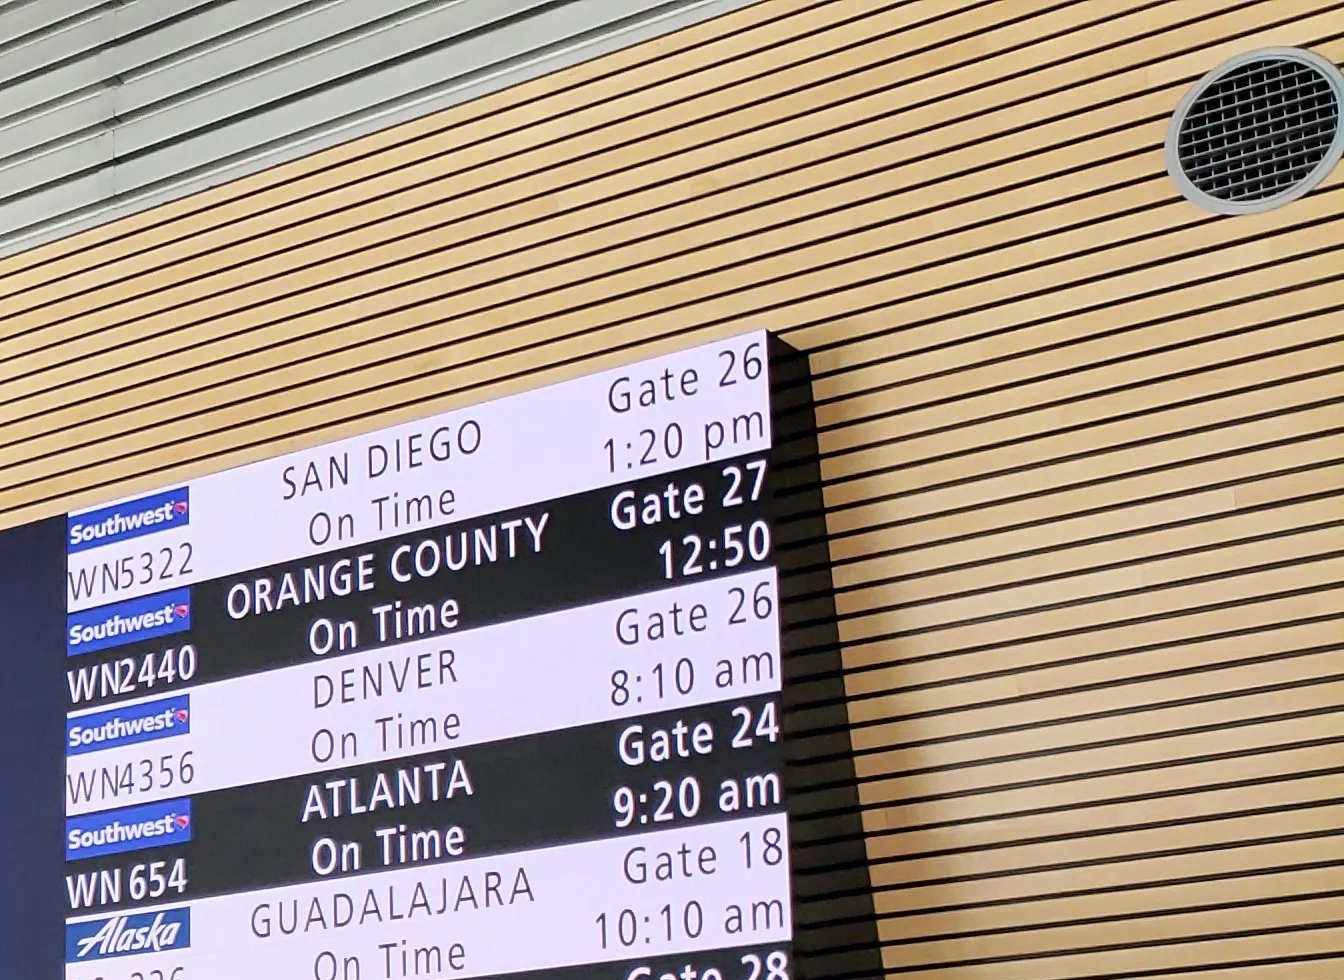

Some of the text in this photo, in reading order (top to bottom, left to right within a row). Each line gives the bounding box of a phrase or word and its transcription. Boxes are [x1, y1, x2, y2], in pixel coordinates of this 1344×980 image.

[607, 342, 763, 416] Gate 26
[281, 419, 483, 502] SAN DIEGO
[603, 409, 765, 473] 1:20 pm
[69, 502, 174, 544] Southwest
[308, 484, 456, 547] On Time
[610, 459, 769, 530] Gate 27
[68, 542, 194, 602] WN5322
[226, 514, 551, 619] ORANGE COUNTY
[658, 520, 772, 580] 12:50
[69, 606, 174, 646] Southwest
[308, 598, 460, 656] On Time
[615, 580, 773, 647] Gate 26
[67, 644, 196, 706] WN2440
[312, 650, 458, 709] DENVER
[610, 648, 774, 708] 8:10 am
[69, 708, 174, 746] Southwest
[311, 708, 461, 764] On Time
[619, 701, 779, 767] Gate 24
[66, 751, 195, 806] WN4356
[301, 760, 473, 823] ATLANTA
[613, 768, 780, 828] 9:20 am
[68, 814, 174, 851] Southwest
[312, 822, 465, 876] On Time
[622, 826, 784, 884] Gate 18
[66, 859, 188, 909] WN 654
[251, 867, 535, 938] GUADALAJARA
[75, 913, 182, 958] Alaska
[595, 895, 784, 951] 10:10 am
[376, 938, 466, 978] Time
